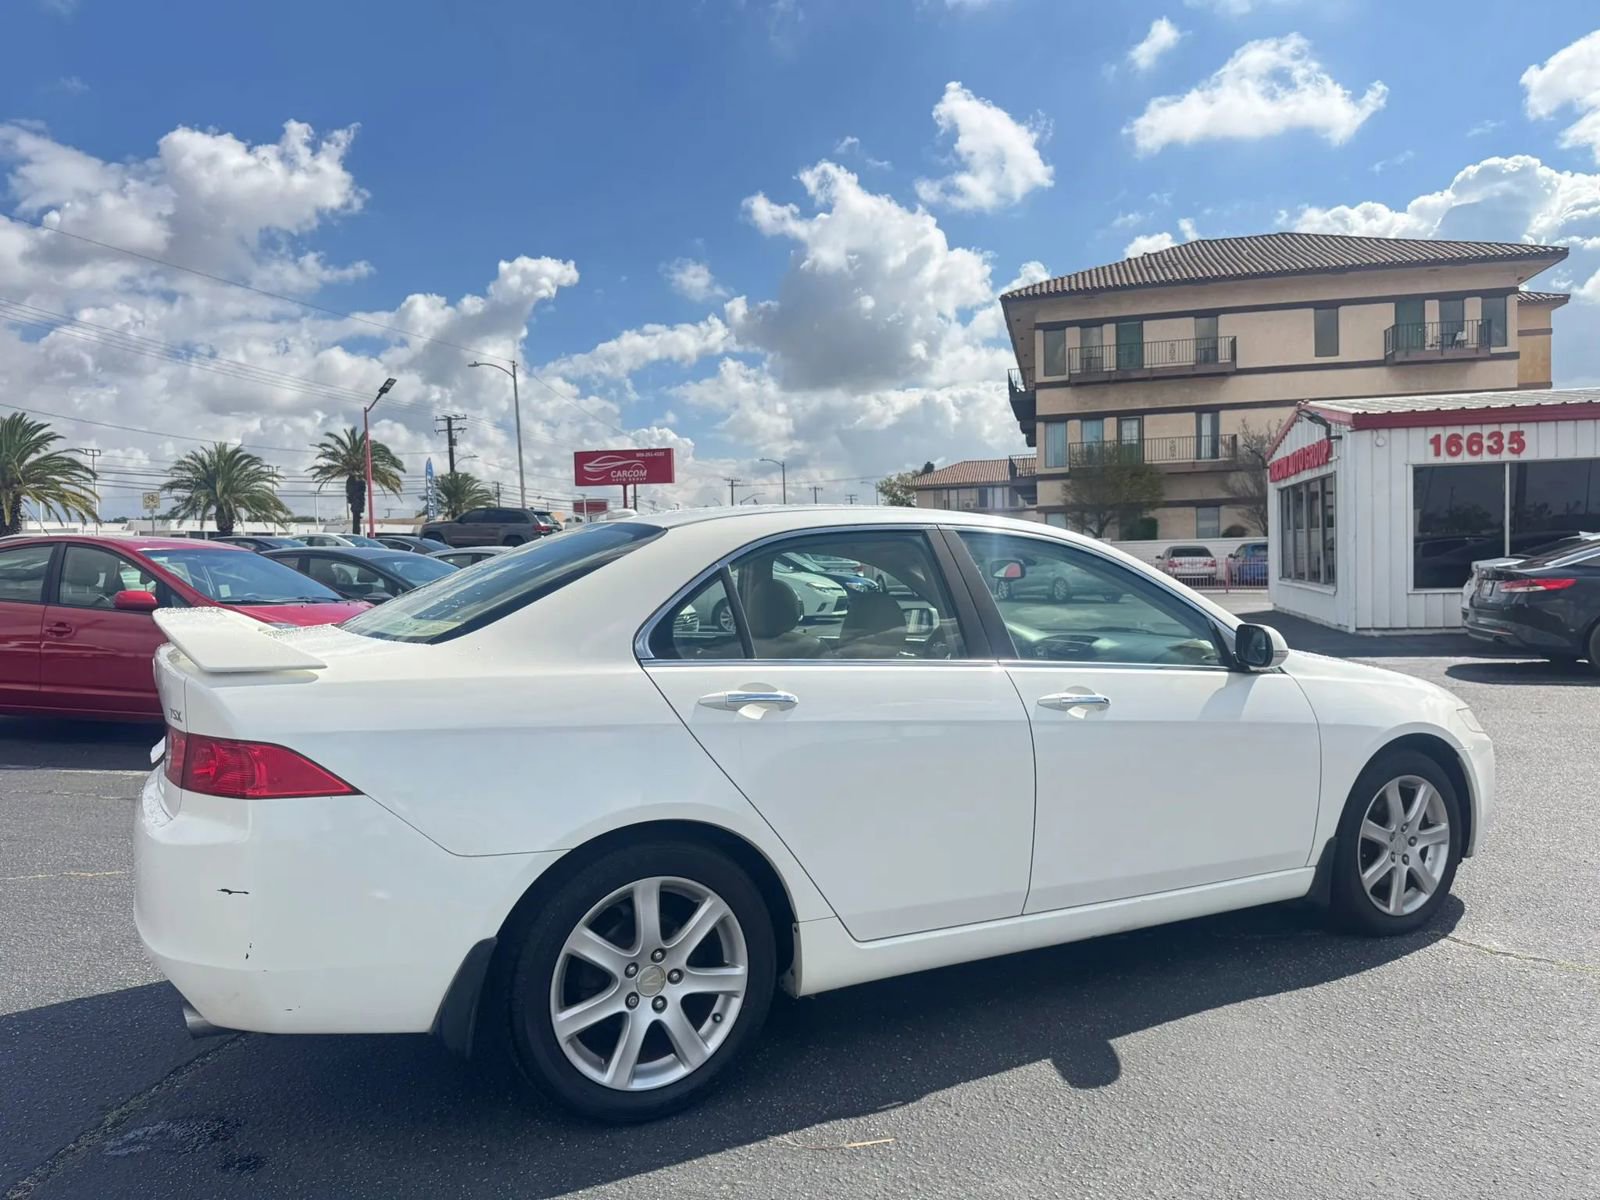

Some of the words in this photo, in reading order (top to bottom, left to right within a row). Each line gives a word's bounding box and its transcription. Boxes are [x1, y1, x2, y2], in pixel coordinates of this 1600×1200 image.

[1288, 447, 1305, 475] AUTO
[1305, 438, 1330, 469] GROUP
[1429, 430, 1526, 458] 16635
[169, 708, 183, 723] TSX
